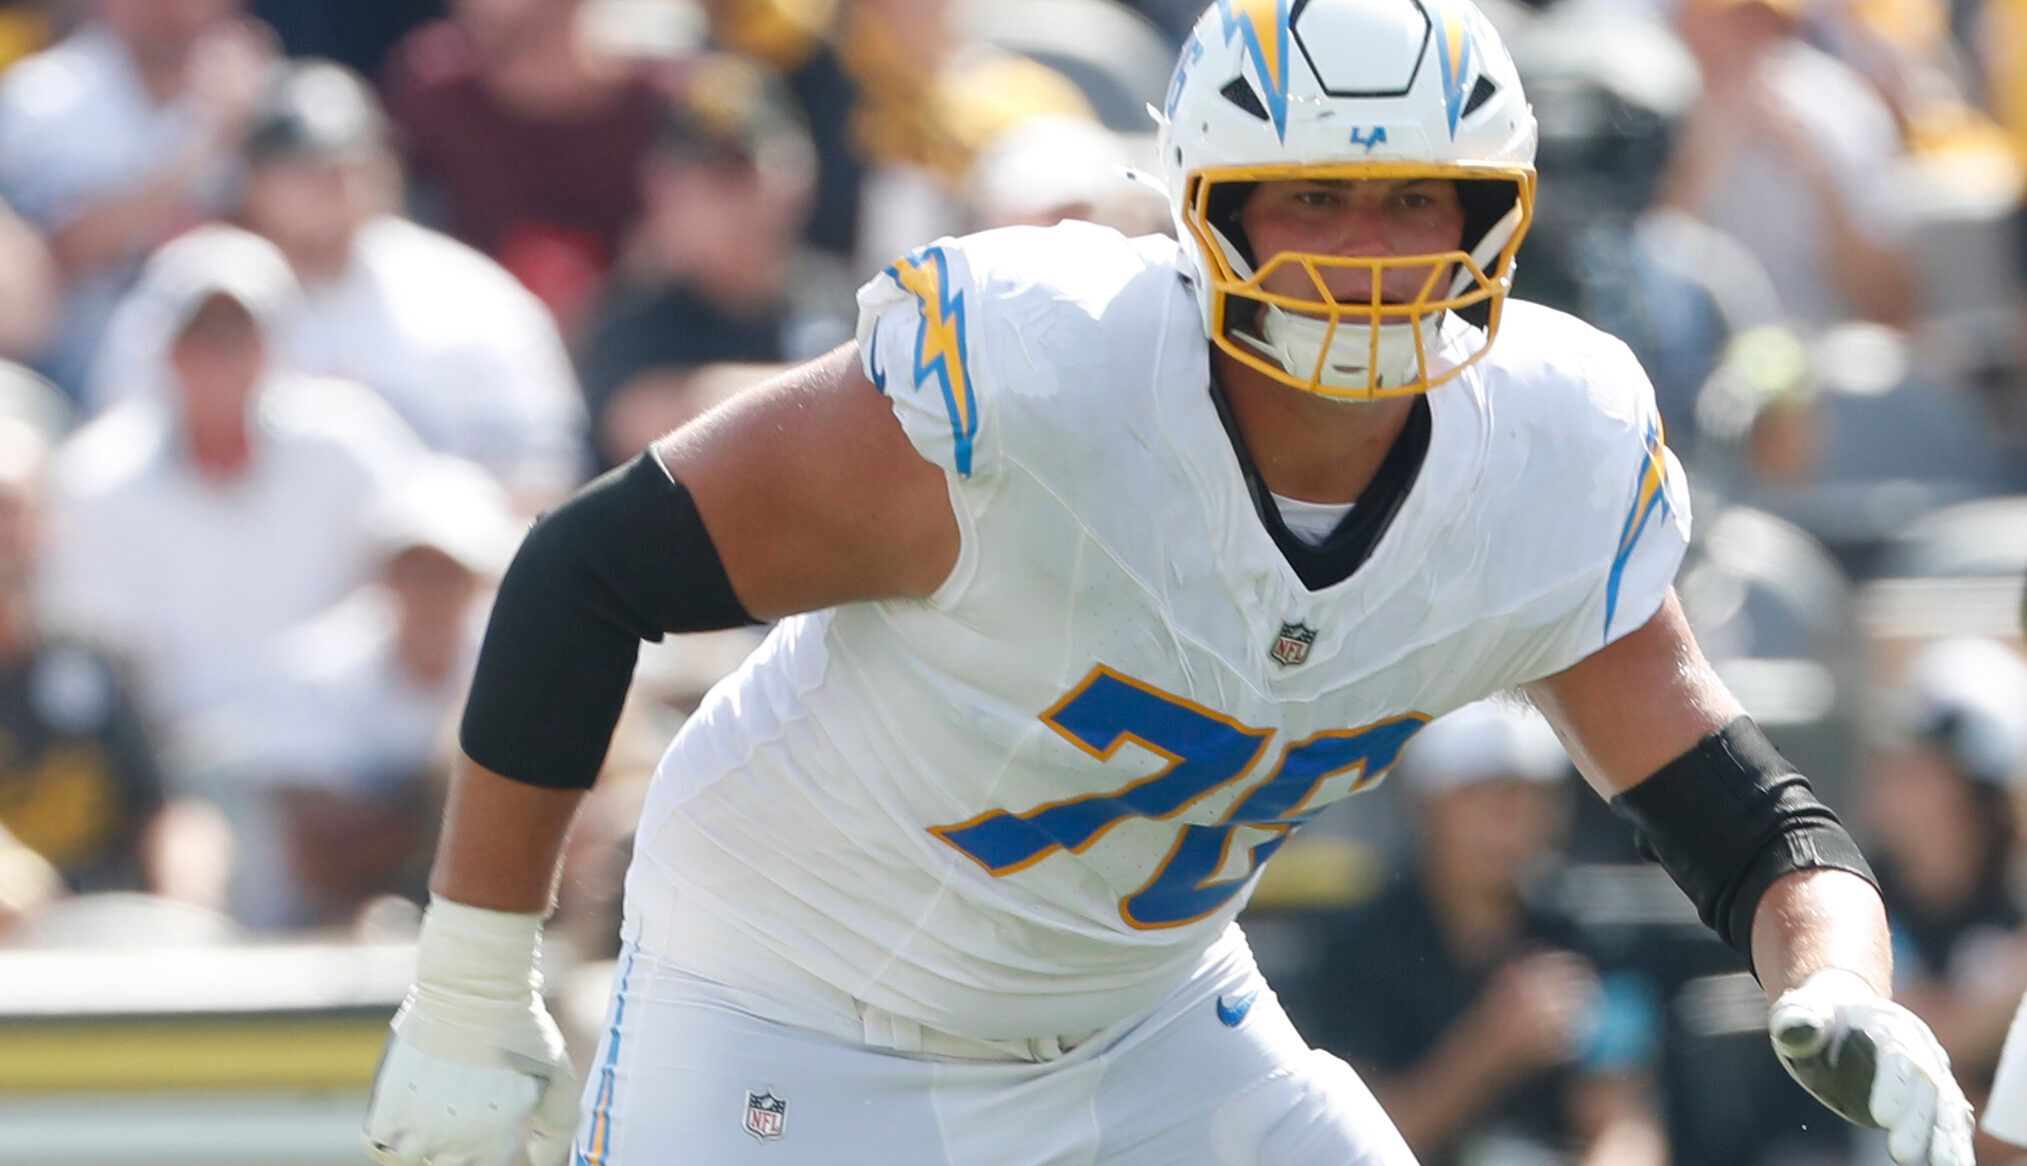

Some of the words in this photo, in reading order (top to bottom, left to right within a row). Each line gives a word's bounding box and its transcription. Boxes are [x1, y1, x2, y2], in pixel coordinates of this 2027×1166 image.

[1350, 126, 1387, 154] LA
[1273, 638, 1307, 662] NFL
[927, 662, 1434, 930] 76
[750, 1108, 782, 1133] NFL
